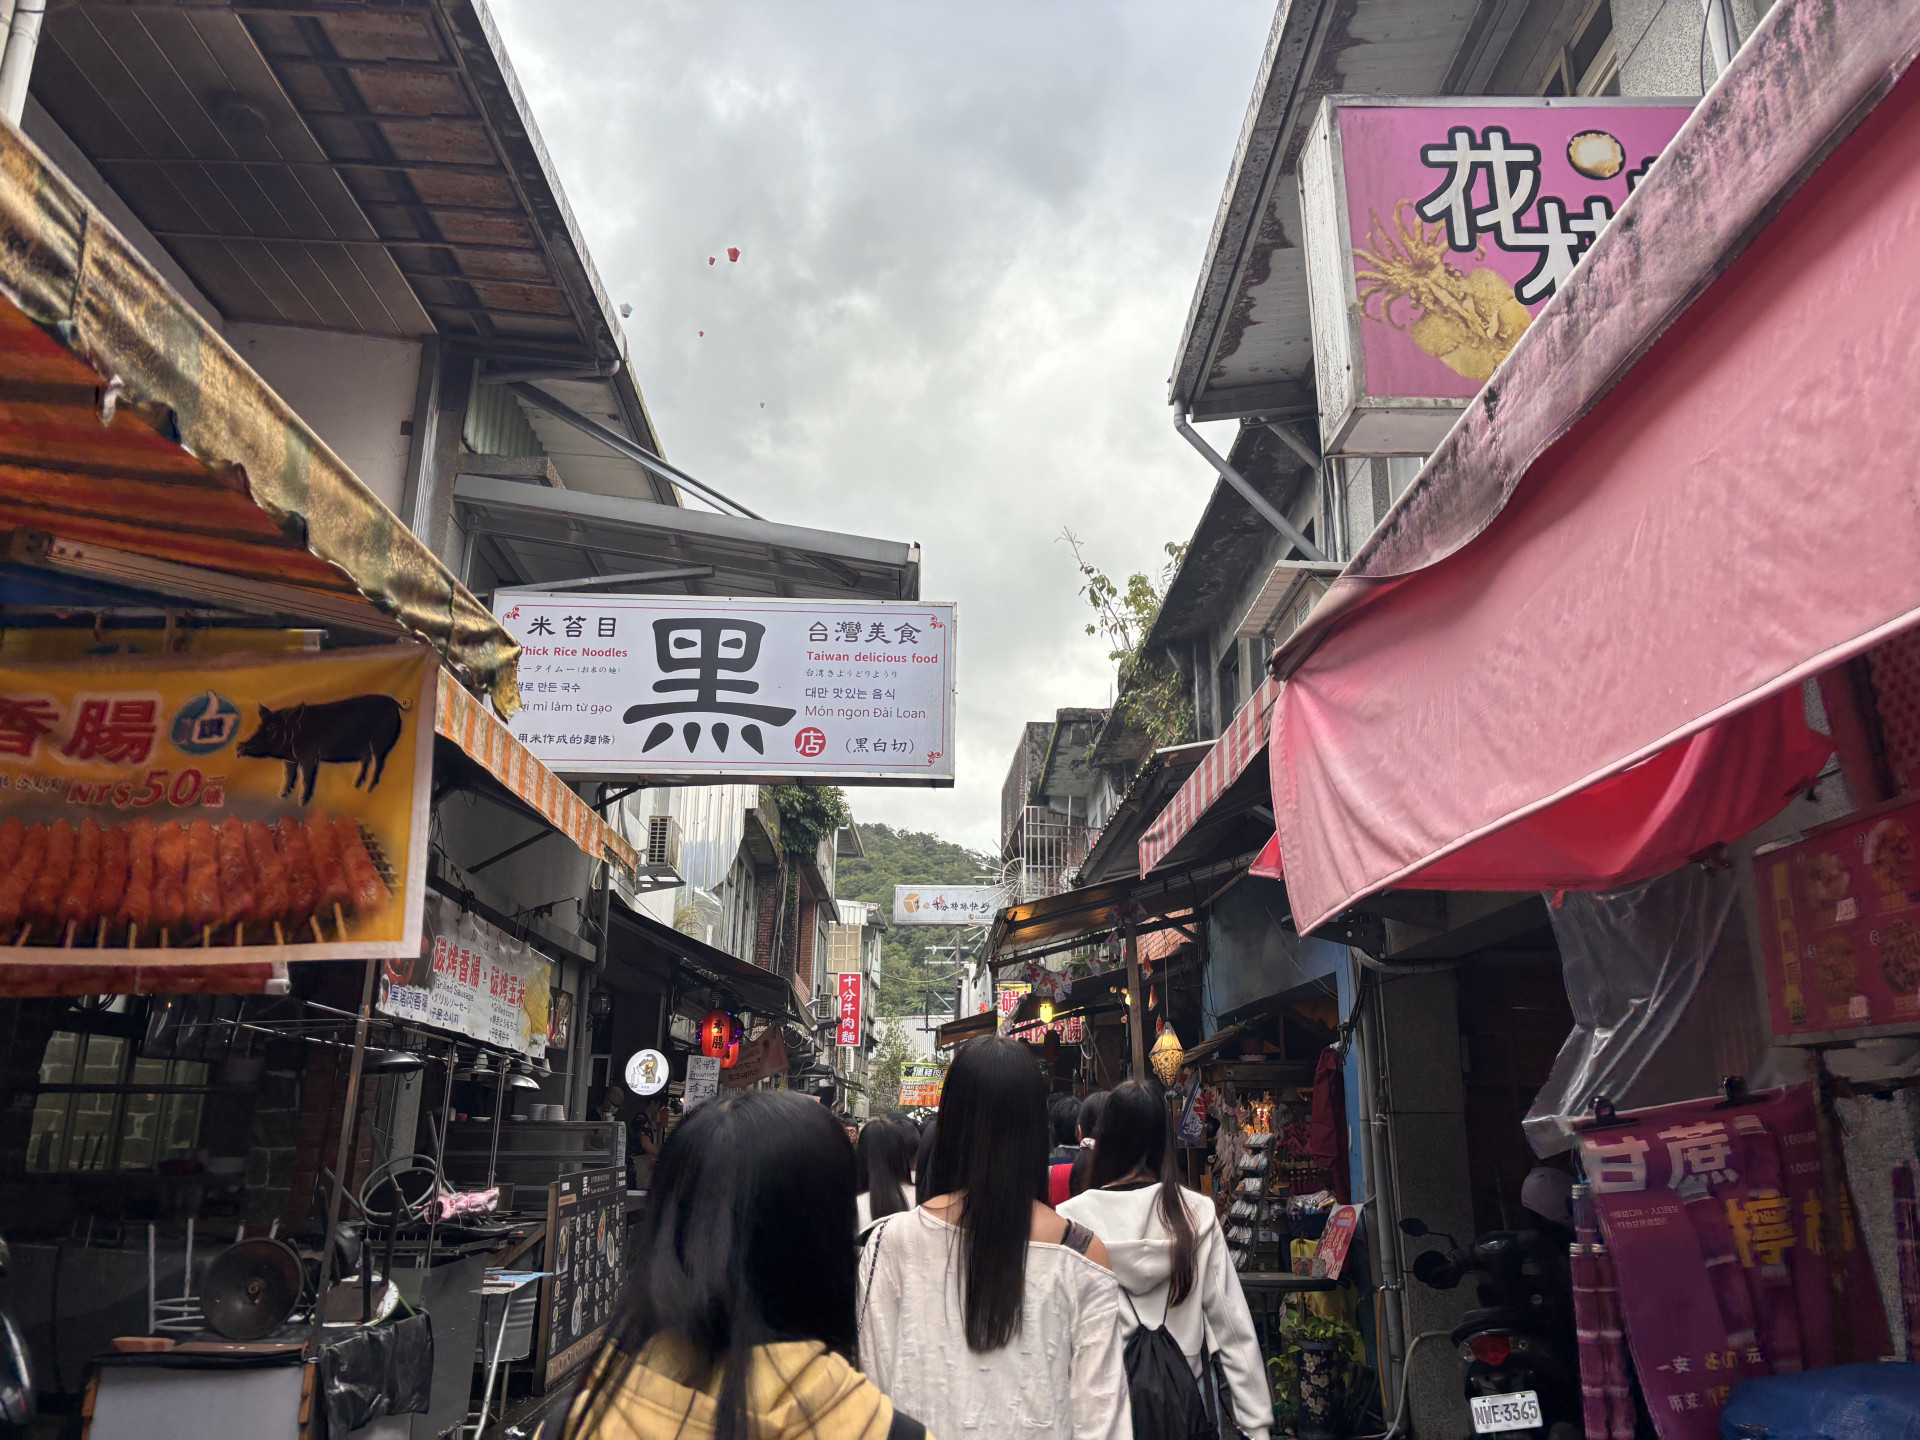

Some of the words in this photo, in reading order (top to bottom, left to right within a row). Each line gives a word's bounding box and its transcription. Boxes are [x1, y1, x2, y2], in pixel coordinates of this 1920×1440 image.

[527, 615, 616, 637] 米苔目
[809, 621, 921, 644] 台灣美食
[554, 647, 577, 657] Rice
[582, 648, 628, 658] Noodles
[807, 651, 849, 661] Taiwan
[854, 652, 907, 663] delicious
[912, 653, 938, 663] food
[538, 682, 557, 692] 만든
[561, 682, 581, 693] 국수
[623, 618, 796, 755] 黑
[805, 687, 828, 699] 대만
[833, 687, 868, 700] 맛있는
[872, 688, 895, 700] 음식
[551, 701, 572, 712] làm
[576, 702, 588, 712] từ
[590, 704, 612, 714] gạo
[805, 705, 834, 717] Món
[838, 708, 870, 720] ngon
[873, 706, 893, 718] Đài
[896, 707, 926, 719] Loan
[0, 699, 158, 763] 香腸
[796, 730, 824, 753] 店
[845, 737, 915, 754] (黑白切)
[68, 768, 203, 807] NT$50
[840, 975, 856, 1045] 十分牛肉麵
[711, 1019, 725, 1049] 香腸
[689, 1082, 717, 1096] 珍珠
[1583, 1121, 1740, 1194] 甘蔗
